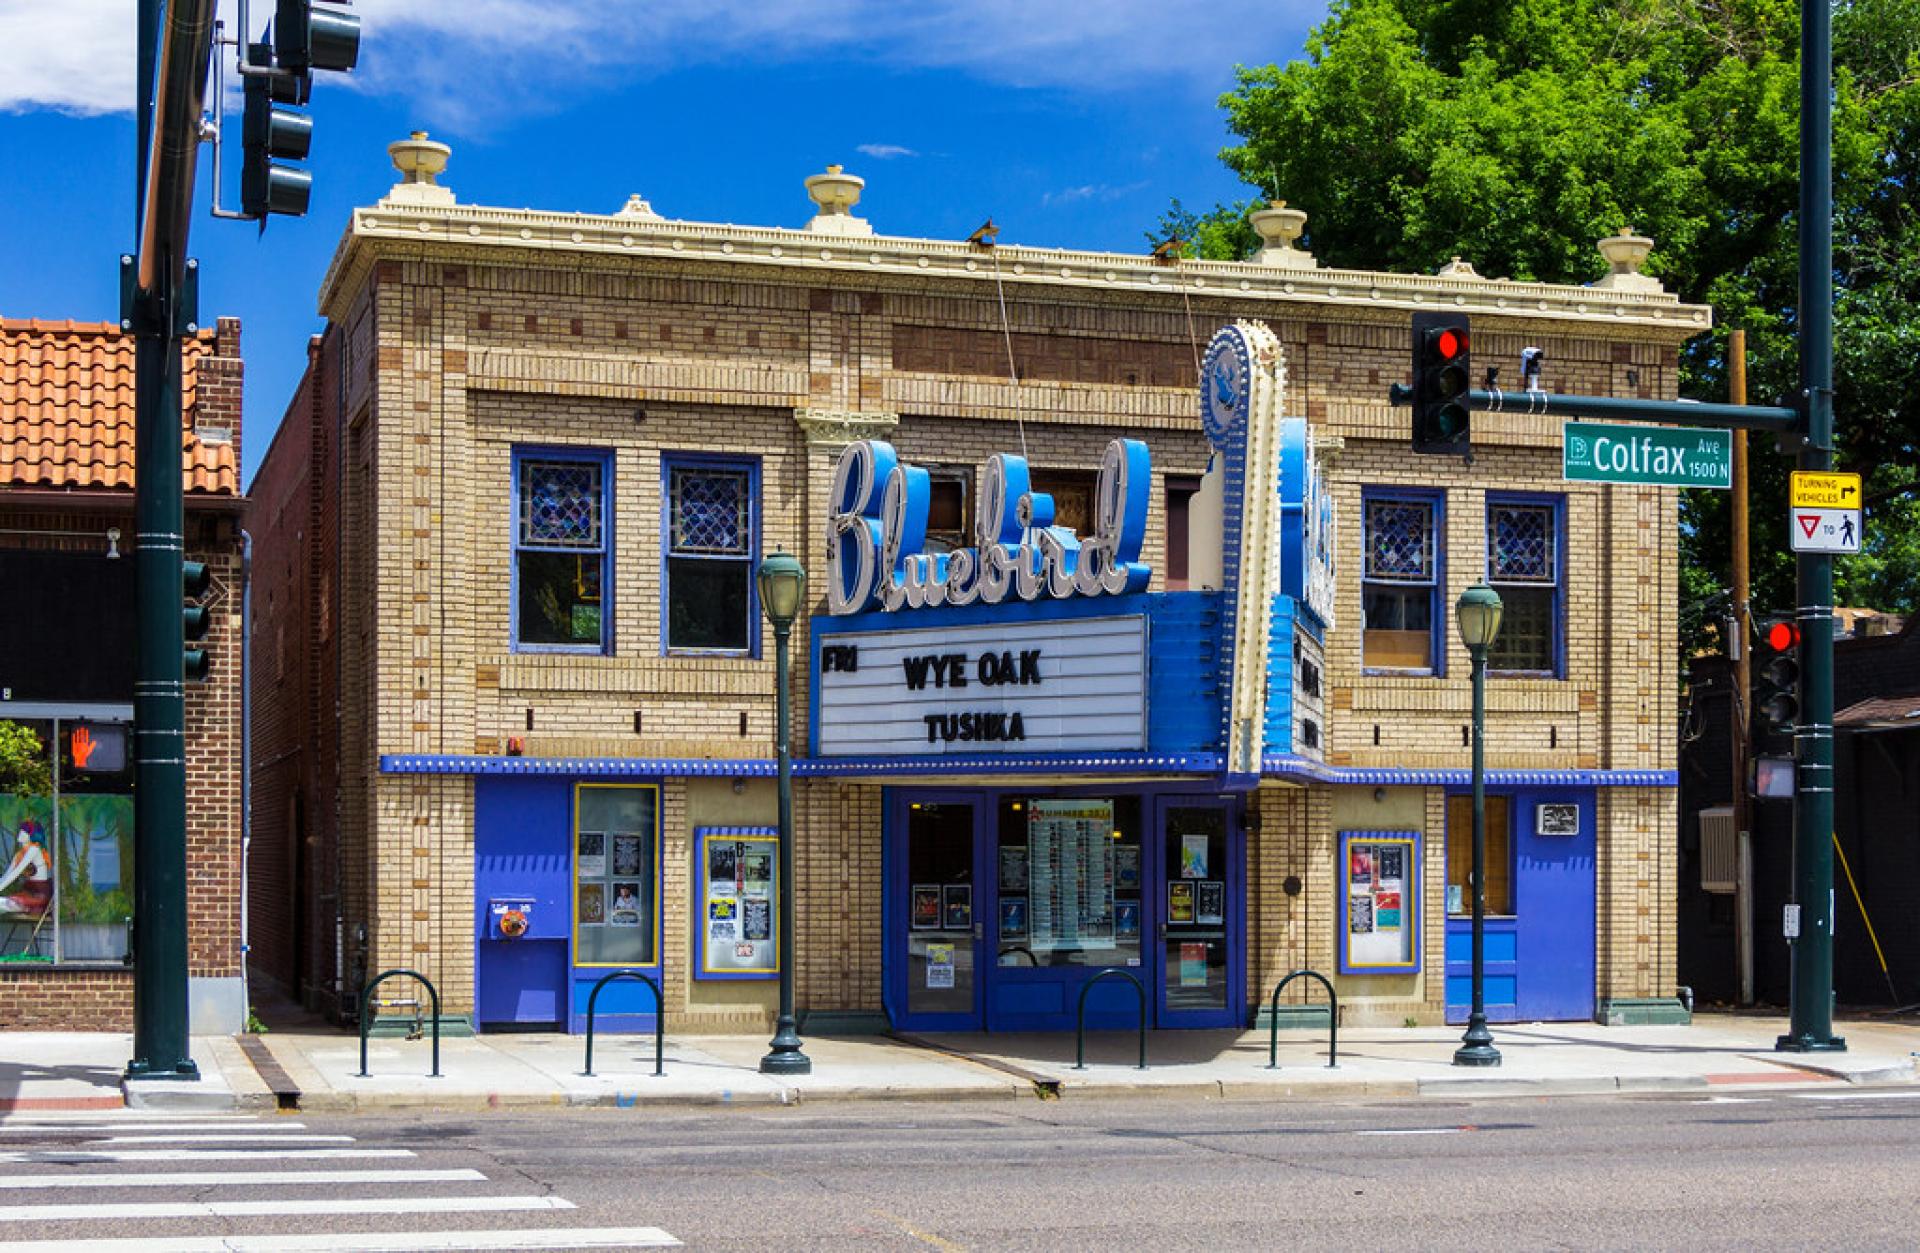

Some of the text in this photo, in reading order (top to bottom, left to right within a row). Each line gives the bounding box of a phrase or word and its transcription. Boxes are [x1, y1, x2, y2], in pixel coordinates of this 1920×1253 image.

[1593, 436, 1686, 475] Colfax
[1697, 438, 1720, 454] Ave
[1689, 462, 1728, 479] 1500 N
[1797, 478, 1838, 489] TURNING
[1796, 493, 1838, 503] VEHICLES
[826, 438, 1151, 615] Bluebird
[1824, 524, 1835, 535] TO
[822, 644, 858, 673] FRI
[903, 648, 1041, 690] WYE OAK
[924, 711, 1025, 743] TUSHKA
